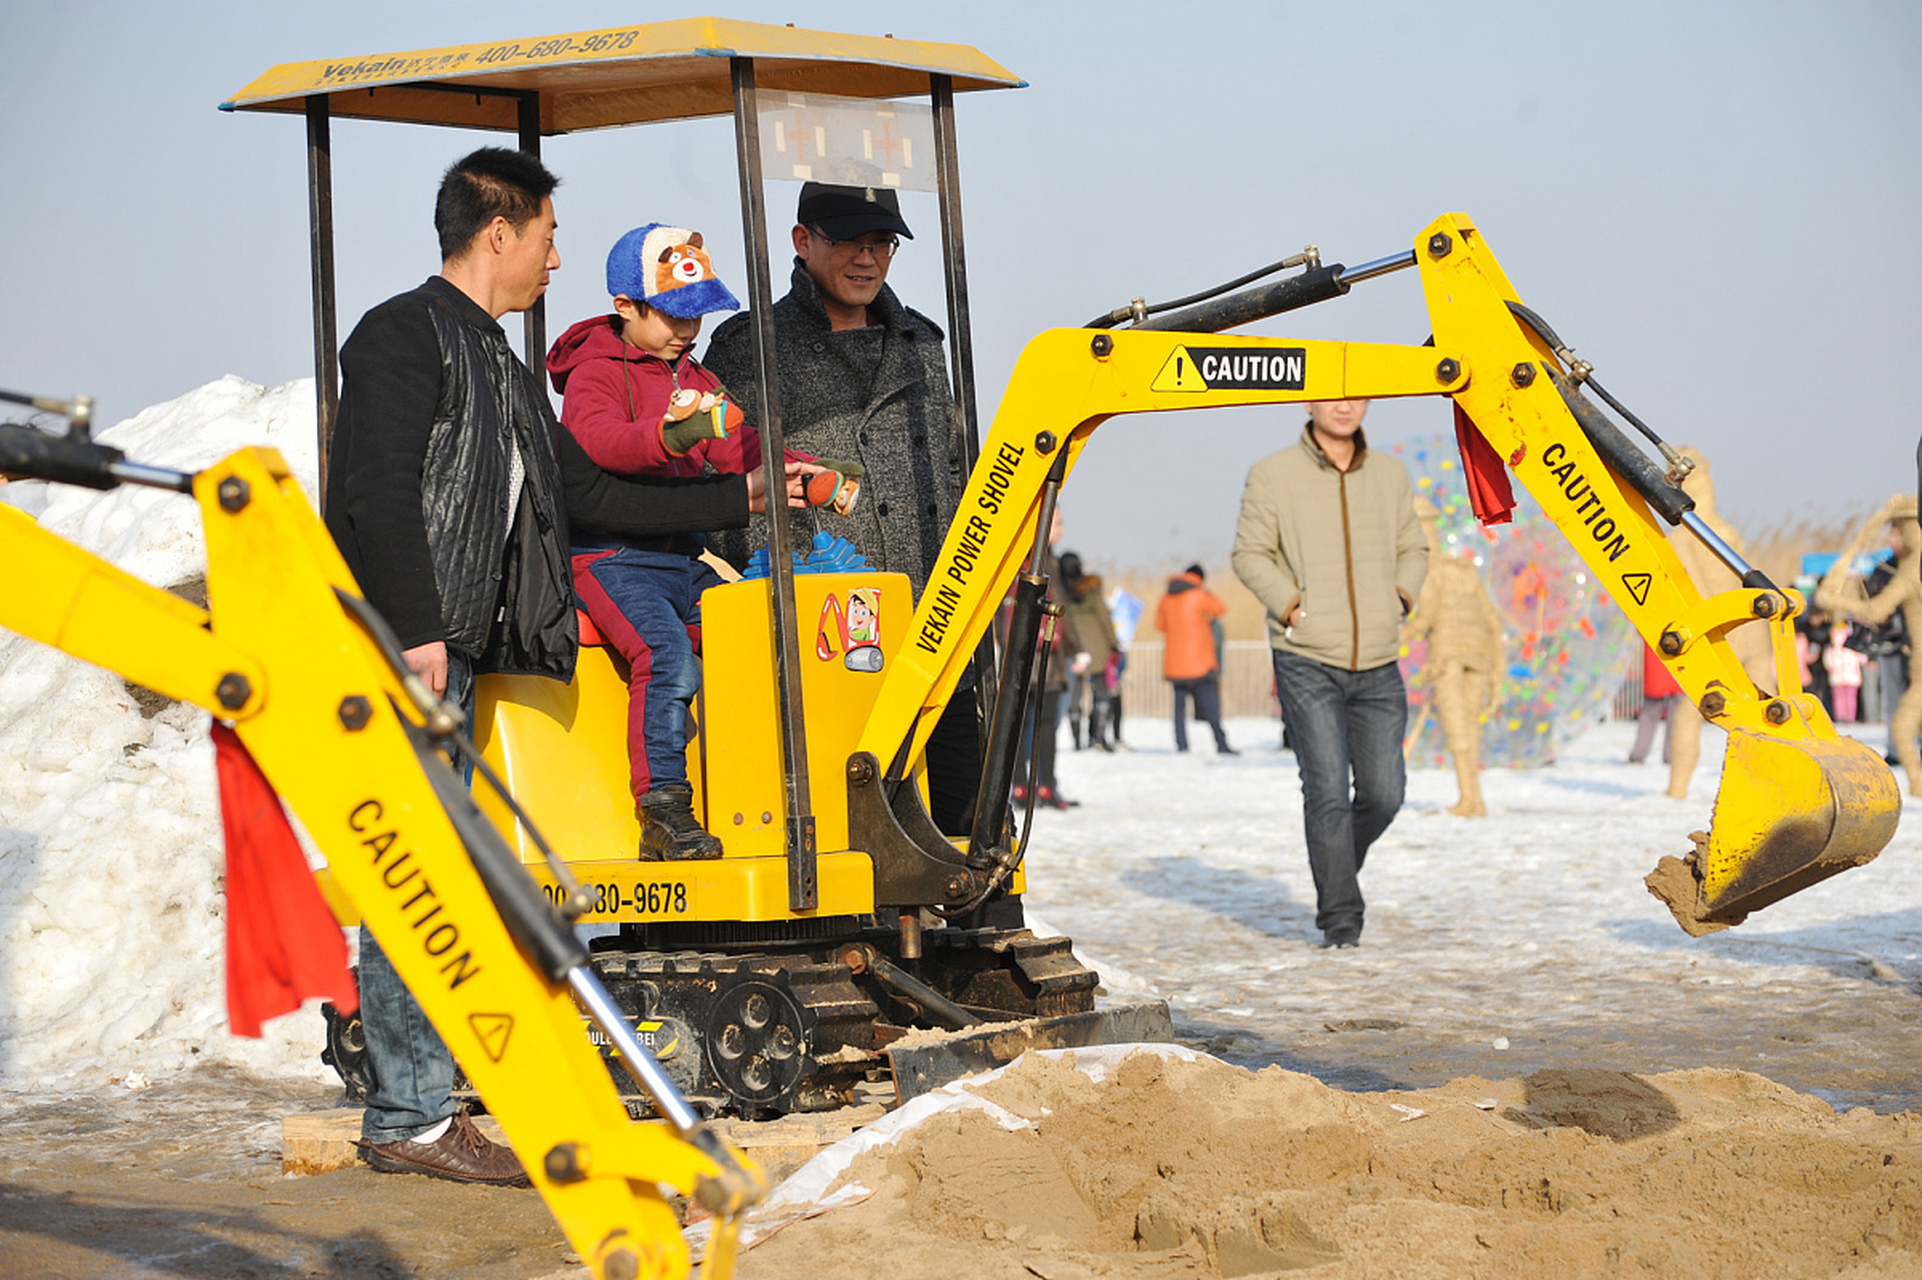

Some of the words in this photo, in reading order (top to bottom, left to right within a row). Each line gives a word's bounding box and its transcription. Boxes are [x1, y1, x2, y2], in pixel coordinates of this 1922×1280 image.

[323, 57, 407, 78] Vekain
[475, 30, 639, 64] 400-680-9678
[1202, 354, 1302, 382] CAUTION
[916, 584, 961, 654] VEKAIN
[947, 515, 992, 585] POWER
[978, 442, 1025, 514] SHOVEL
[1542, 443, 1631, 562] CAUTION
[348, 799, 481, 990] CAUTION
